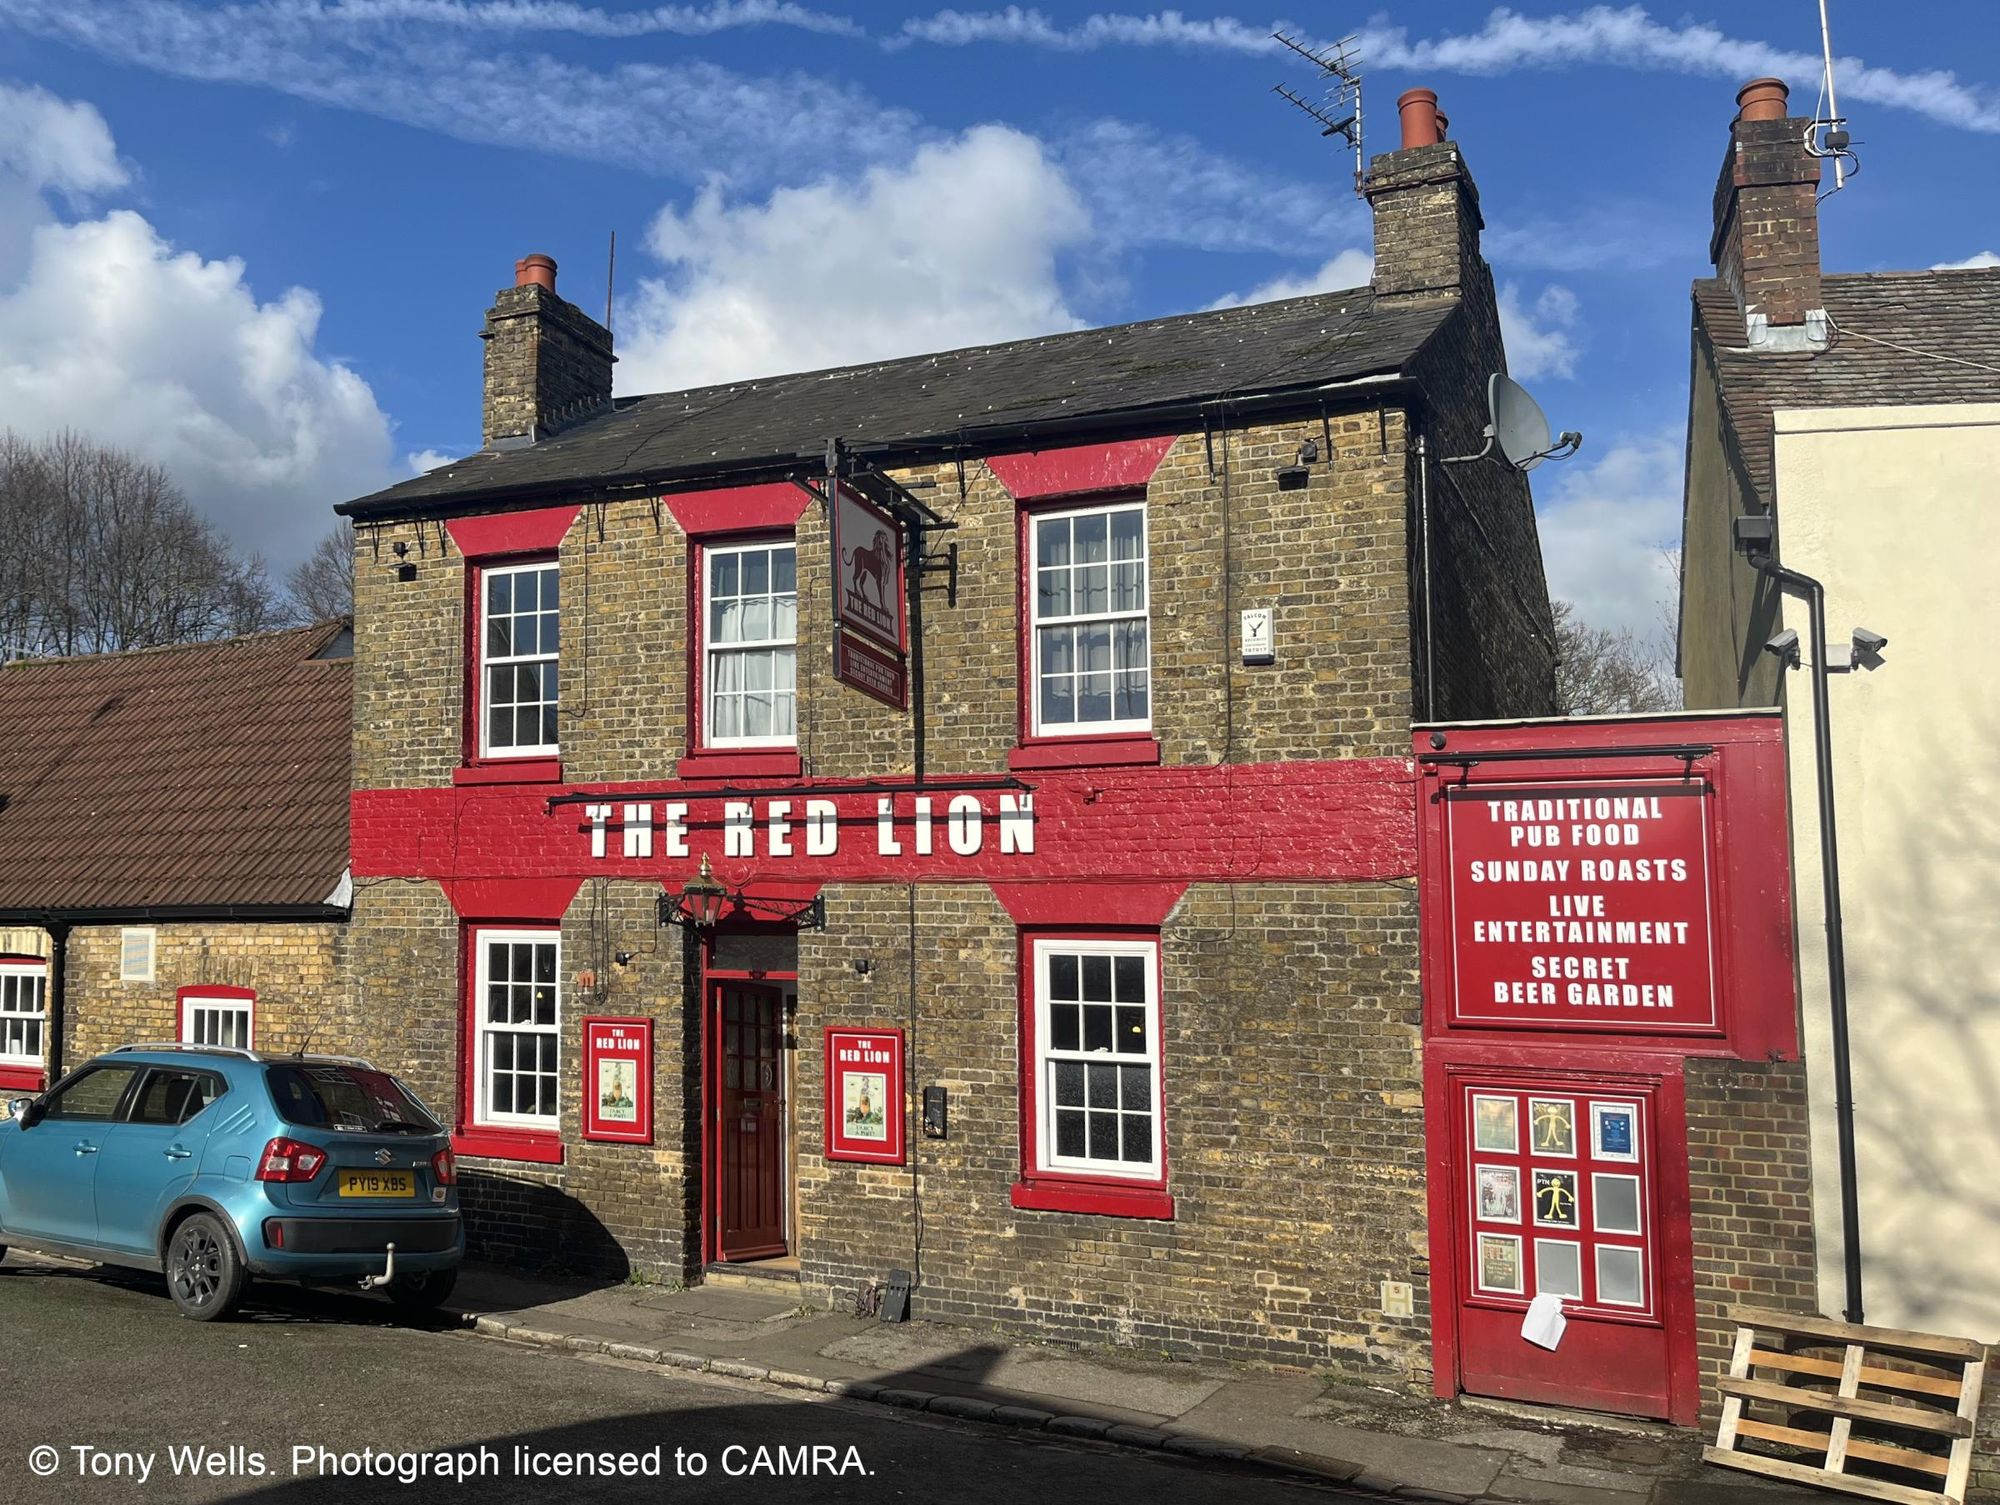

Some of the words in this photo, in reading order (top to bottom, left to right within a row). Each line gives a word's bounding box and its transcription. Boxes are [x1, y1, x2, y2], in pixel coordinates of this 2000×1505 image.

[849, 595, 862, 613] THE
[863, 603, 876, 621] RED
[876, 611, 891, 631] LION
[1488, 797, 1662, 822] TRADITIONAL
[585, 803, 689, 857] THE
[724, 800, 838, 856] RED
[877, 794, 1035, 855] LION
[1511, 825, 1561, 847] PUB
[1572, 824, 1640, 846] FOOD
[1471, 860, 1570, 882] SUNDAY
[1581, 859, 1687, 881] ROASTS
[1549, 895, 1605, 917] LIVE
[1473, 921, 1688, 944] ENTERTAINMENT
[1531, 957, 1630, 979] SECRET
[1494, 982, 1556, 1004] BEER
[1568, 983, 1674, 1007] GARDEN
[596, 1038, 615, 1049] RED
[617, 1038, 640, 1050] LION
[611, 1029, 624, 1037] THE
[857, 1040, 872, 1049] THE
[840, 1050, 860, 1061] RED
[864, 1051, 890, 1063] LION
[349, 1176, 379, 1191] PY19
[382, 1176, 406, 1191] XBS
